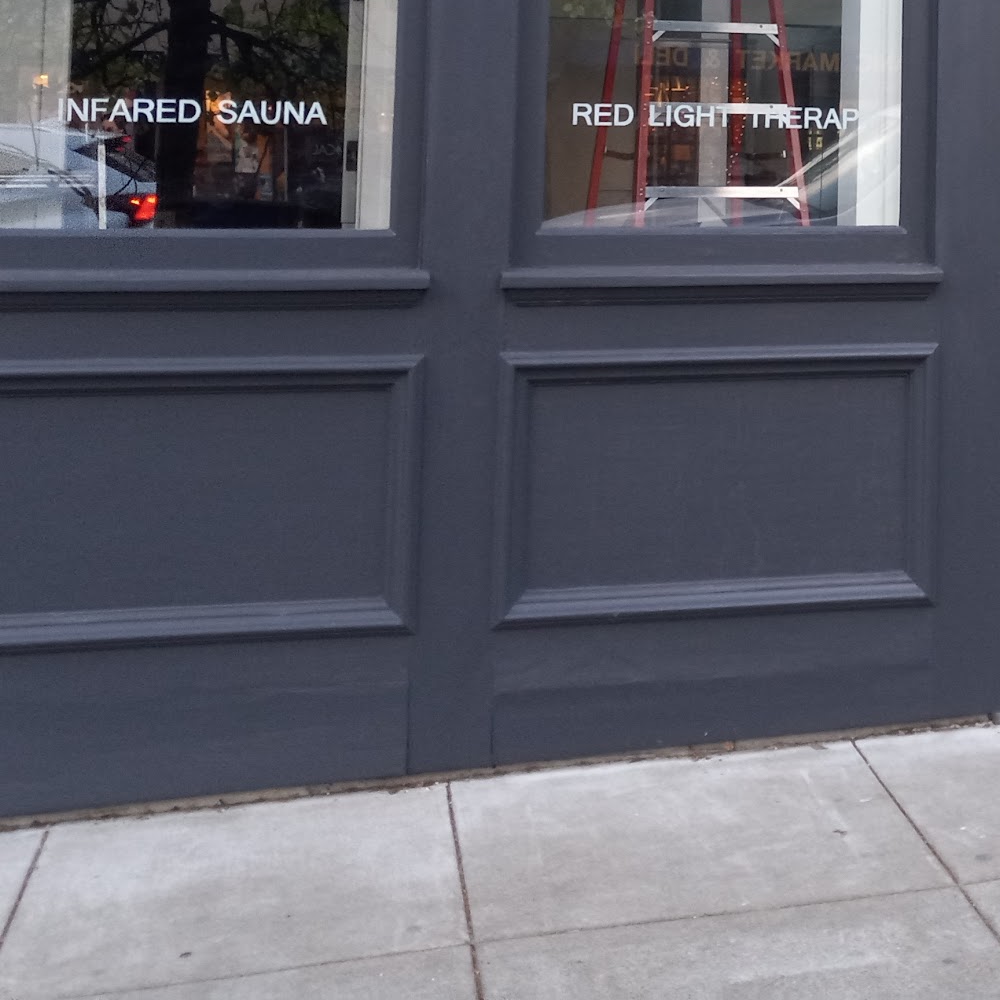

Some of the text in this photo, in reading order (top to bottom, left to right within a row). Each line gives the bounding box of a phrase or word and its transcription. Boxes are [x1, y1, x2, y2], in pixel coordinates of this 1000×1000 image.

[57, 97, 328, 126] INFARED SAUNA
[571, 102, 860, 130] RED LIGHT THERAP
